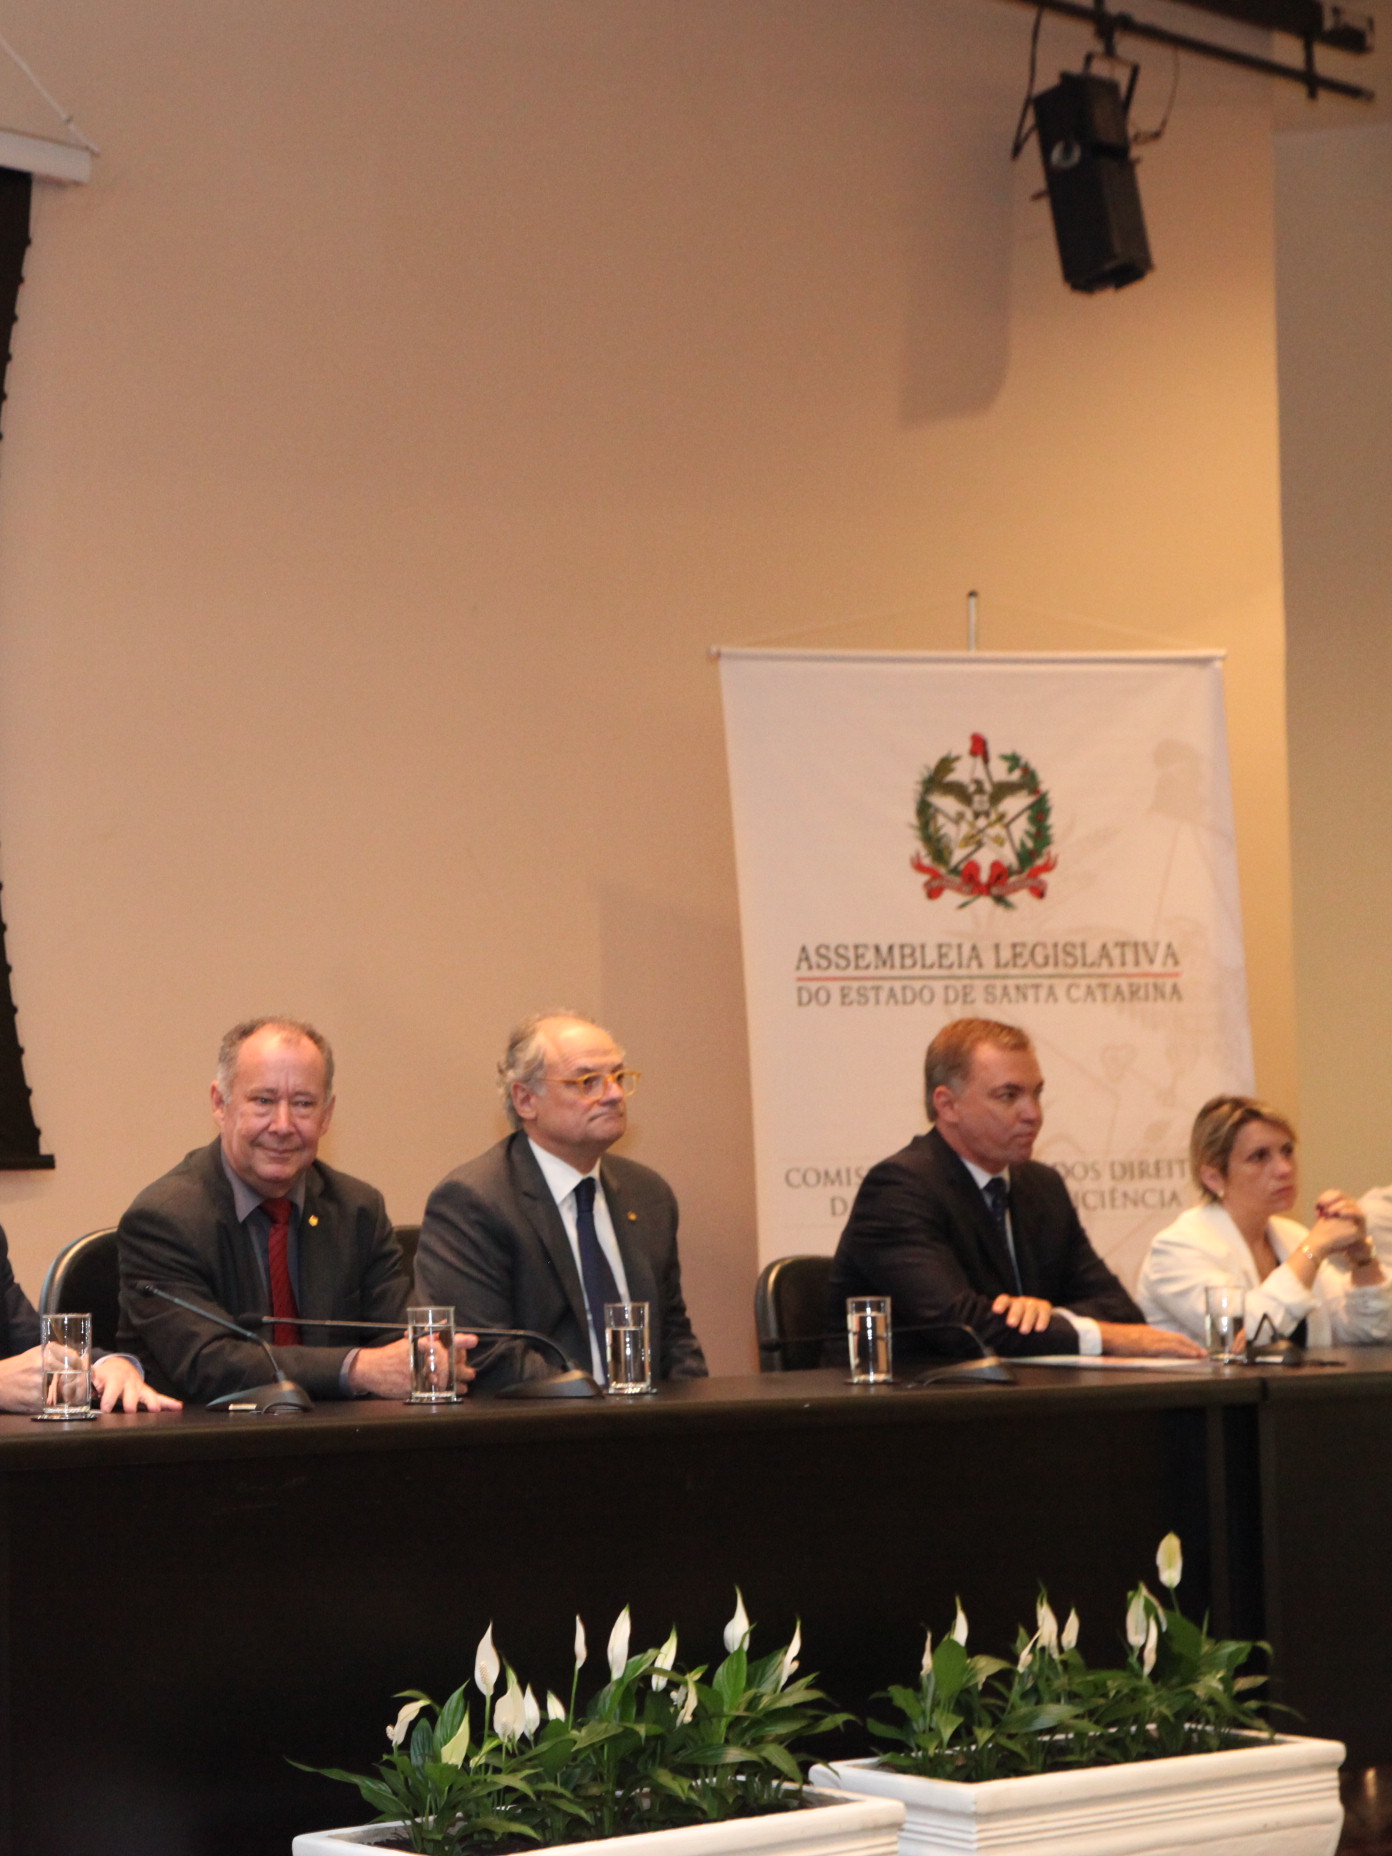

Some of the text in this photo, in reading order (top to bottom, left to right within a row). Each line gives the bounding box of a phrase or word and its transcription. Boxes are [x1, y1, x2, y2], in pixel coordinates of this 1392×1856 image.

[795, 940, 1181, 972] ASSEMBLEIA LEGISLATIVA
[796, 981, 1184, 1008] DO ESTADO DE SANTA CATARINA
[1110, 1159, 1186, 1181] DIREIT
